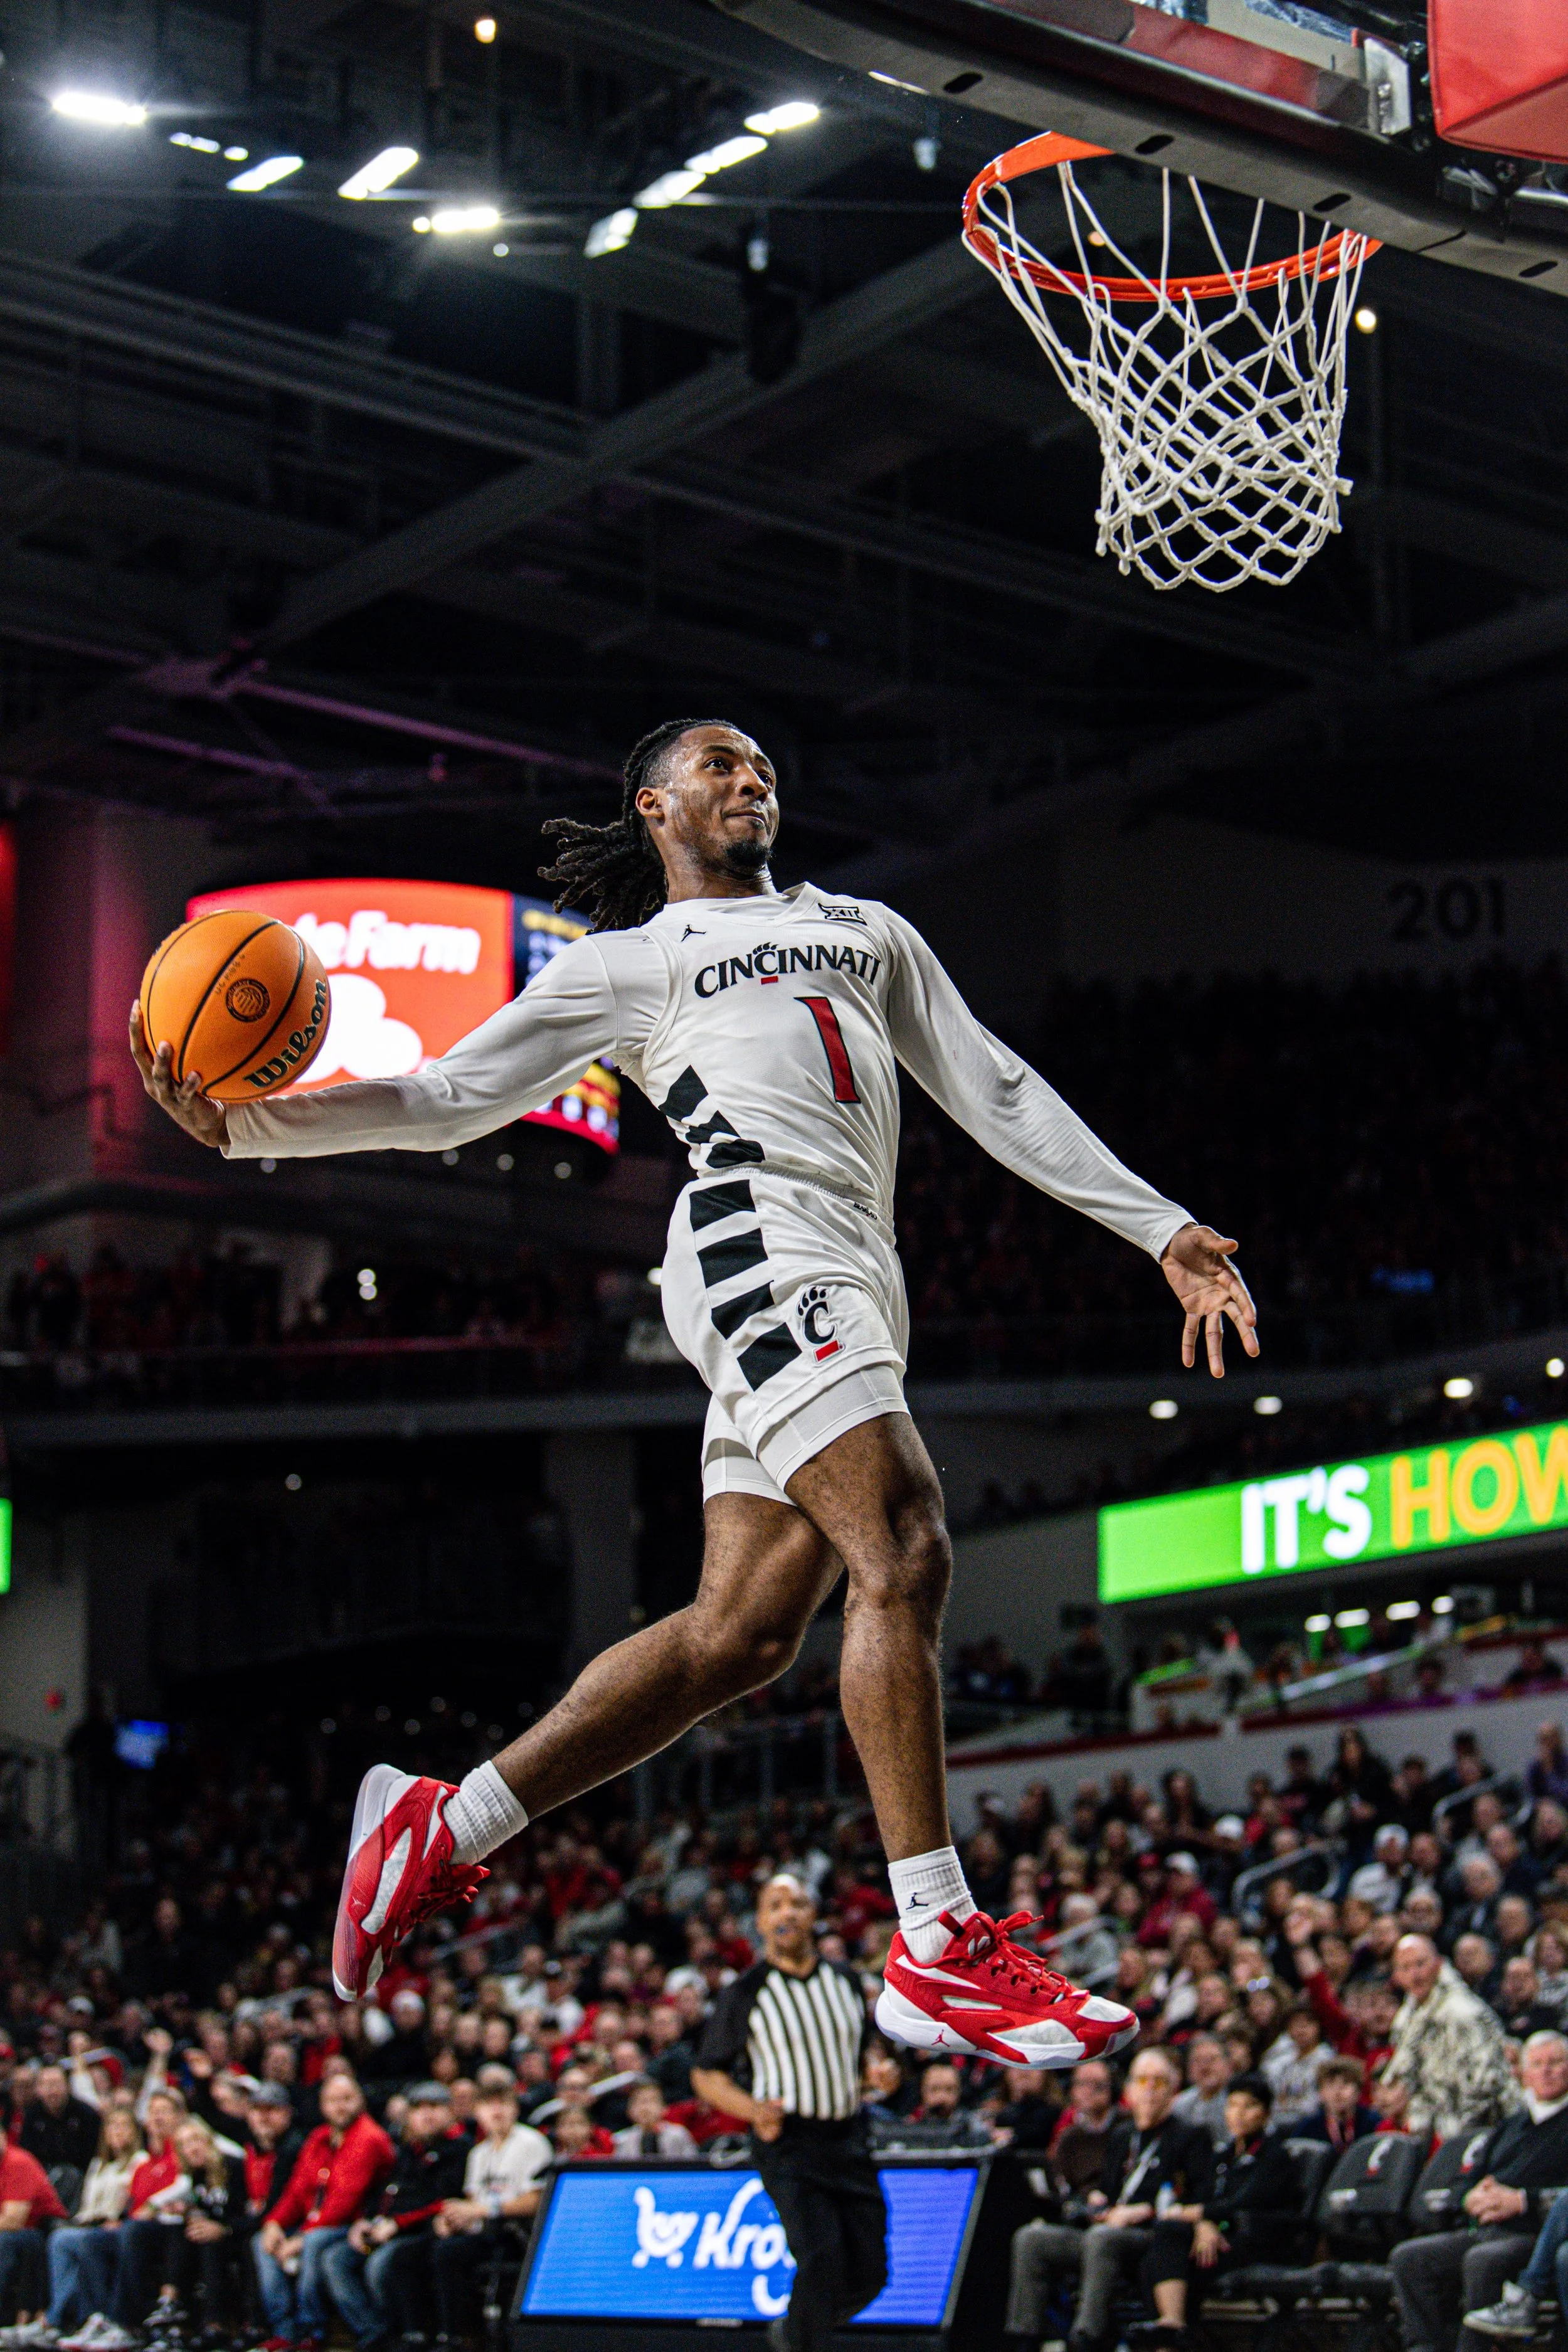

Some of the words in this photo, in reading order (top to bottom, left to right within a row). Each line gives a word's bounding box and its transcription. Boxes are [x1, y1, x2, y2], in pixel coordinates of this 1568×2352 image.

[1390, 879, 1503, 940] 201
[694, 942, 882, 999] CINCINNATI
[243, 978, 327, 1088] Wilson
[793, 996, 861, 1104] 1
[1240, 1465, 1372, 1574] IT'S
